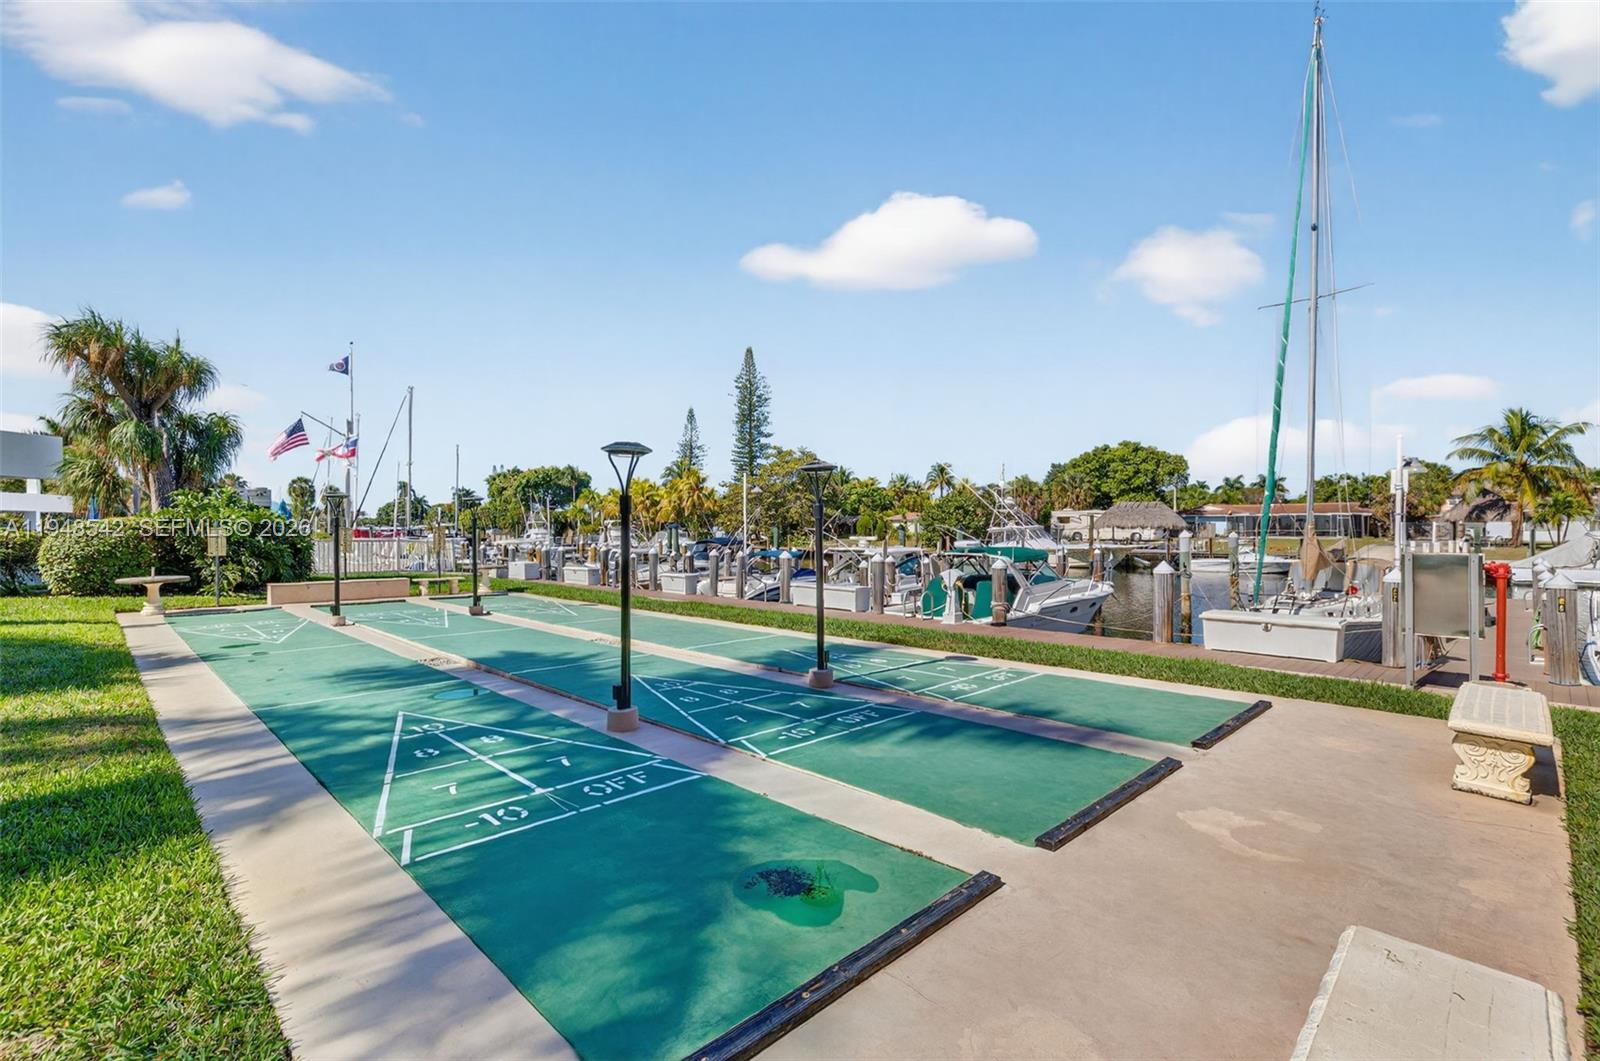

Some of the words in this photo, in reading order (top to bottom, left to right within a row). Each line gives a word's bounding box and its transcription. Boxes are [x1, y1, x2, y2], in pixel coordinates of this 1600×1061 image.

[546, 755, 571, 767] 7
[432, 782, 457, 796] 7
[583, 771, 649, 796] OFF
